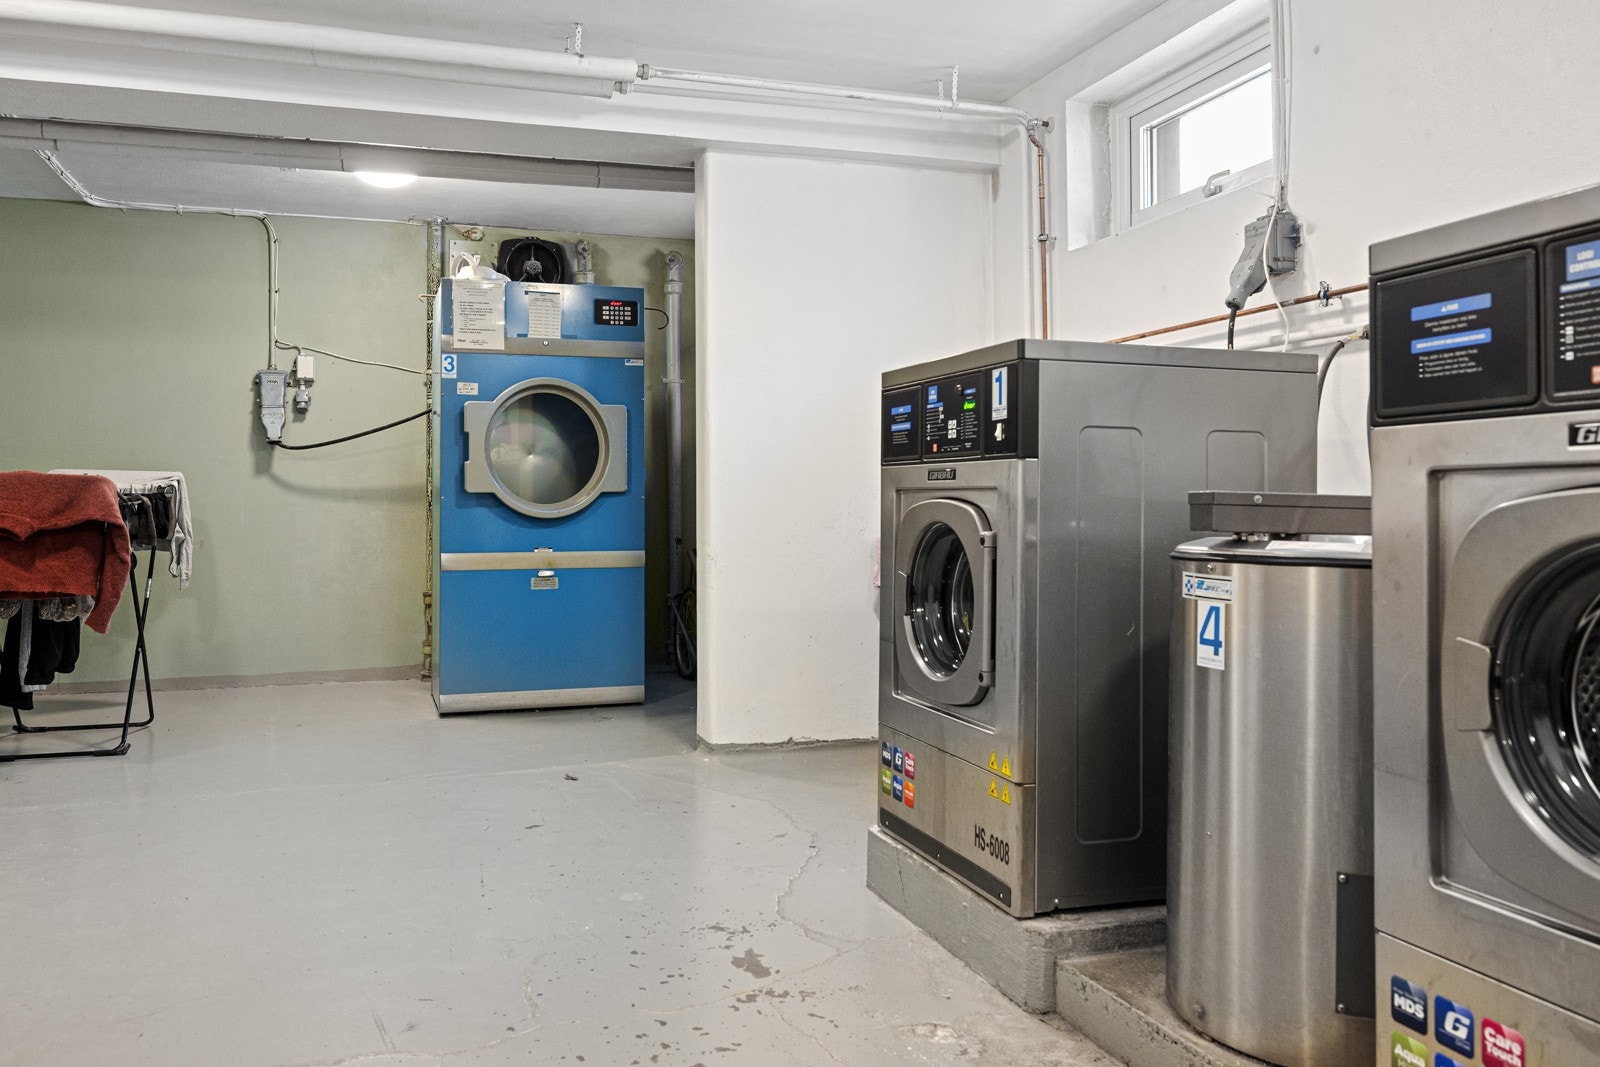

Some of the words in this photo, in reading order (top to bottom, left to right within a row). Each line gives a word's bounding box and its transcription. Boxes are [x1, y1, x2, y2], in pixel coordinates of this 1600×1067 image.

[443, 355, 455, 373] 3
[995, 370, 1003, 406] 1
[928, 470, 954, 480] GIRBAU
[1199, 605, 1223, 656] 4
[974, 824, 1010, 866] HS-6008
[1393, 992, 1425, 1020] MDS
[1443, 1010, 1471, 1040] G
[1394, 1043, 1425, 1067] Aqua
[1483, 1026, 1522, 1056] Care
[1484, 1039, 1522, 1067] Touch
